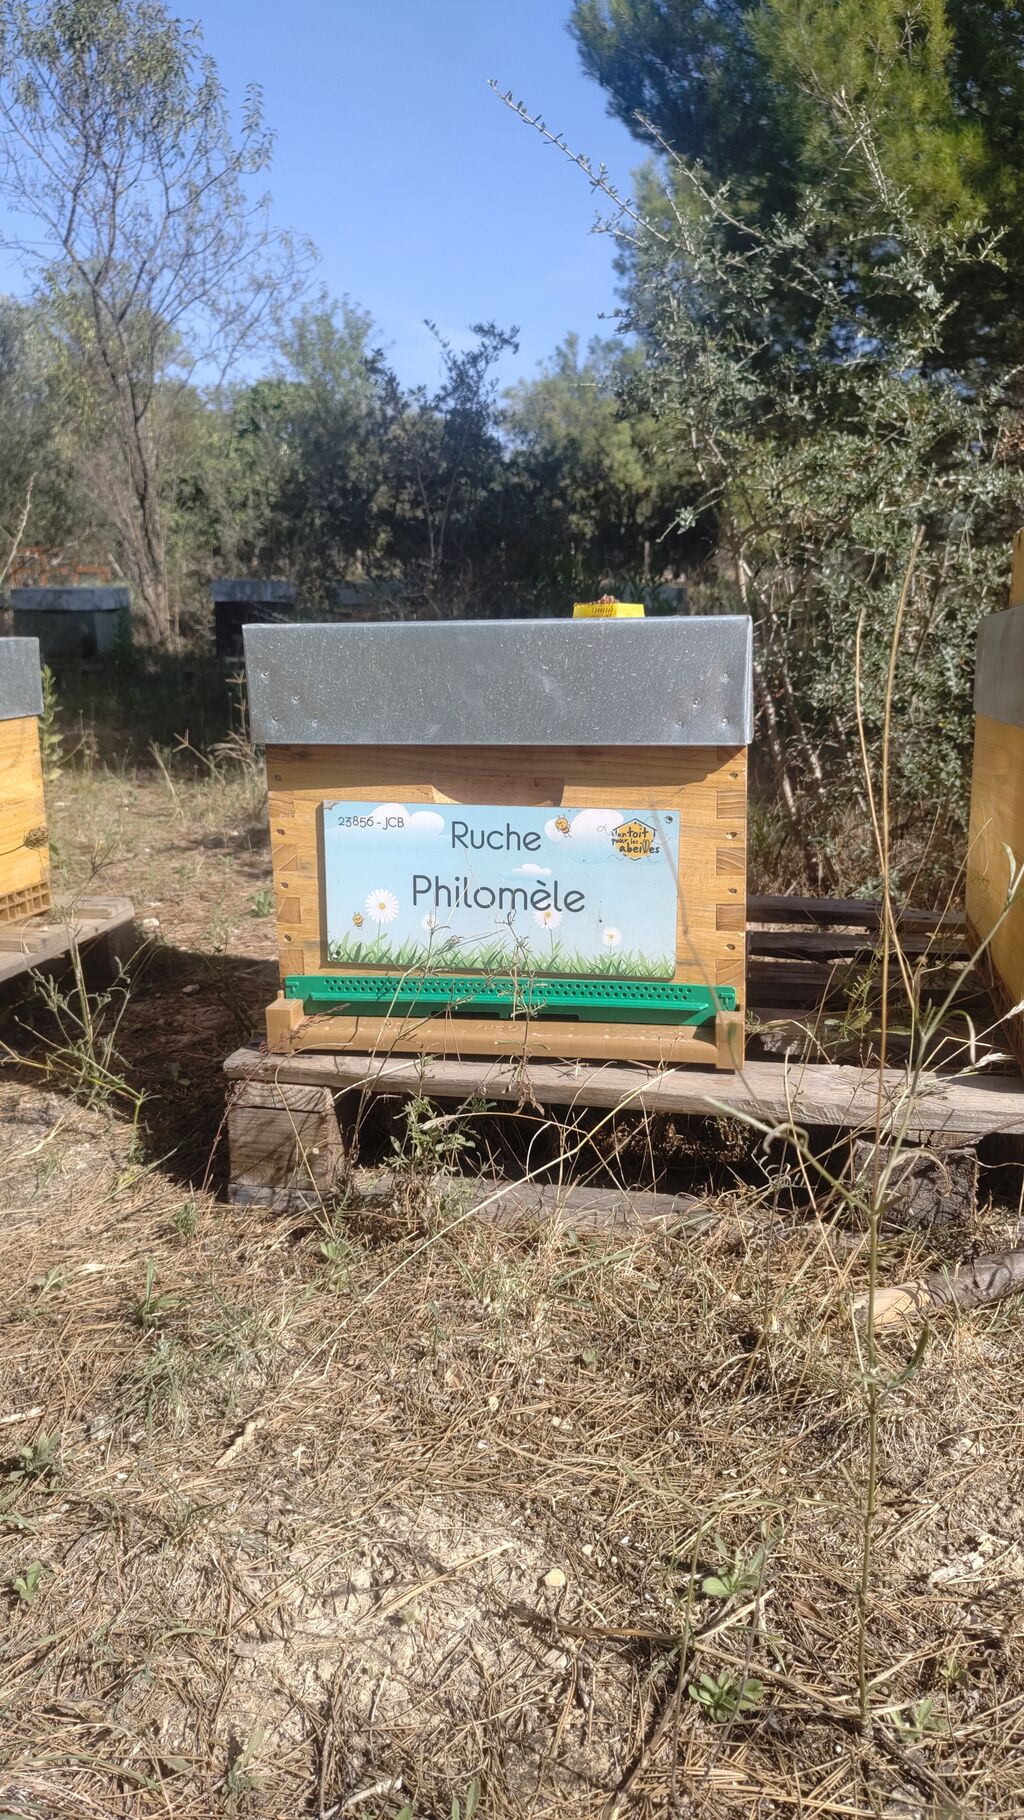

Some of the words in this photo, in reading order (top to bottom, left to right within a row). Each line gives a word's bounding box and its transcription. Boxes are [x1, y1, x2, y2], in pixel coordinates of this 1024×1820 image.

[338, 815, 374, 828] 23856
[382, 816, 405, 831] JCB
[626, 827, 649, 838] toit
[451, 821, 542, 851] Ruche
[412, 874, 586, 913] Philomèle
